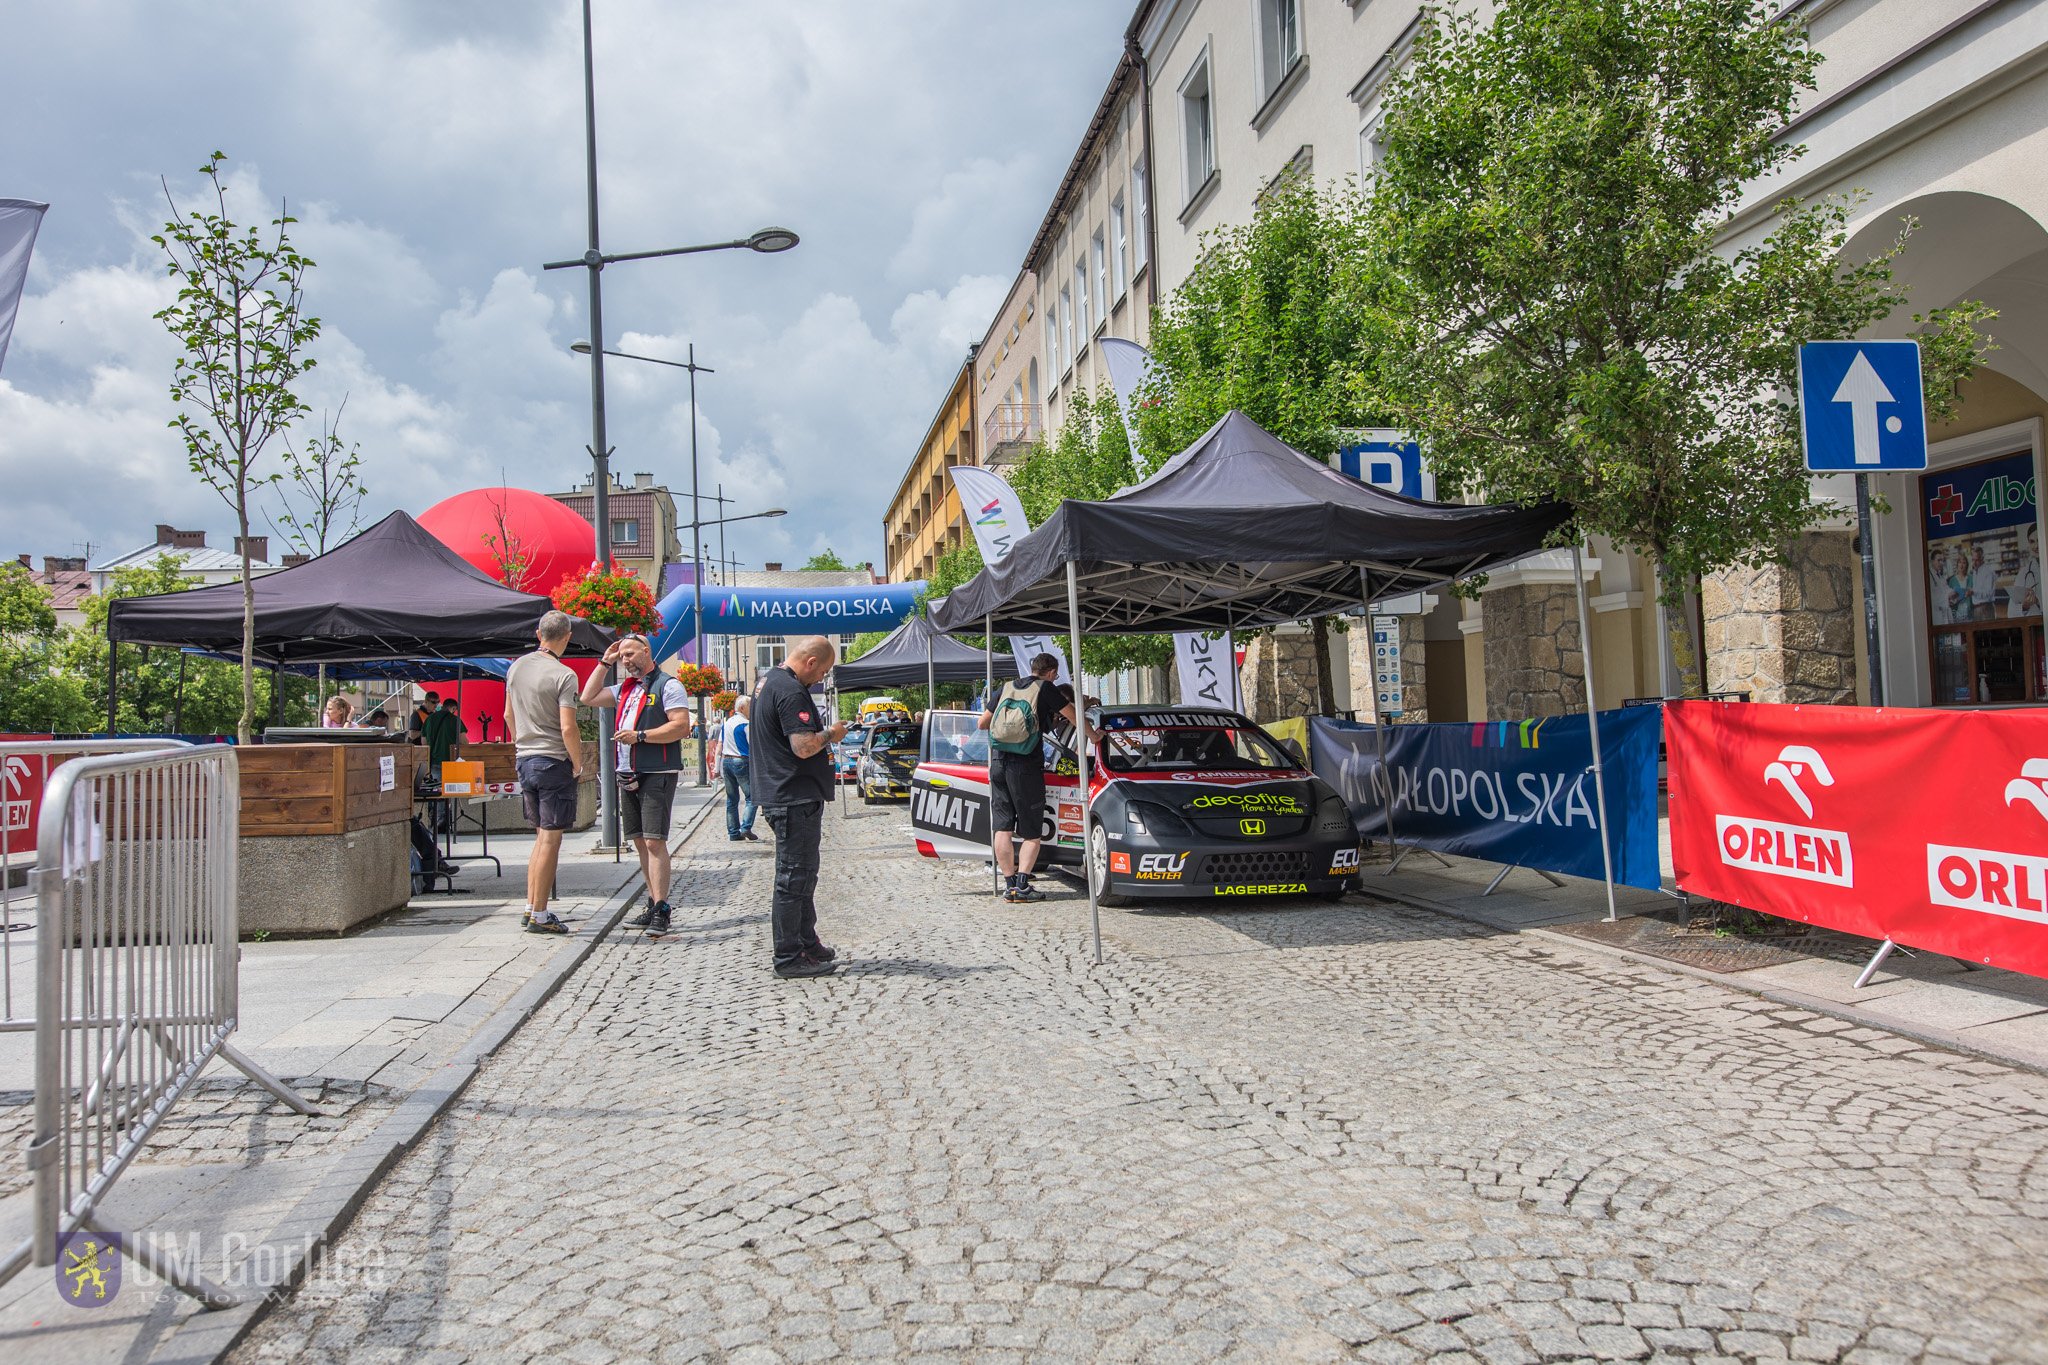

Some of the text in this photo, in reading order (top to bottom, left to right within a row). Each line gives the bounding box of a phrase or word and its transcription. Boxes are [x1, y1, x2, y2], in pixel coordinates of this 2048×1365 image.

[751, 597, 894, 618] MAŁOPOLSKA
[1139, 714, 1242, 728] MULTIMAT
[1197, 771, 1271, 780] AMIDENT
[1193, 793, 1295, 808] decofire
[1370, 761, 1598, 830] MAŁOPOLSKA
[7, 804, 29, 827] EN
[1331, 848, 1360, 868] ECU
[1723, 823, 1844, 878] ORLEN
[1138, 852, 1188, 872] ECU
[1136, 871, 1183, 880] MASTER
[1938, 855, 2048, 914] ORL
[1214, 883, 1308, 896] LAGEREZZA
